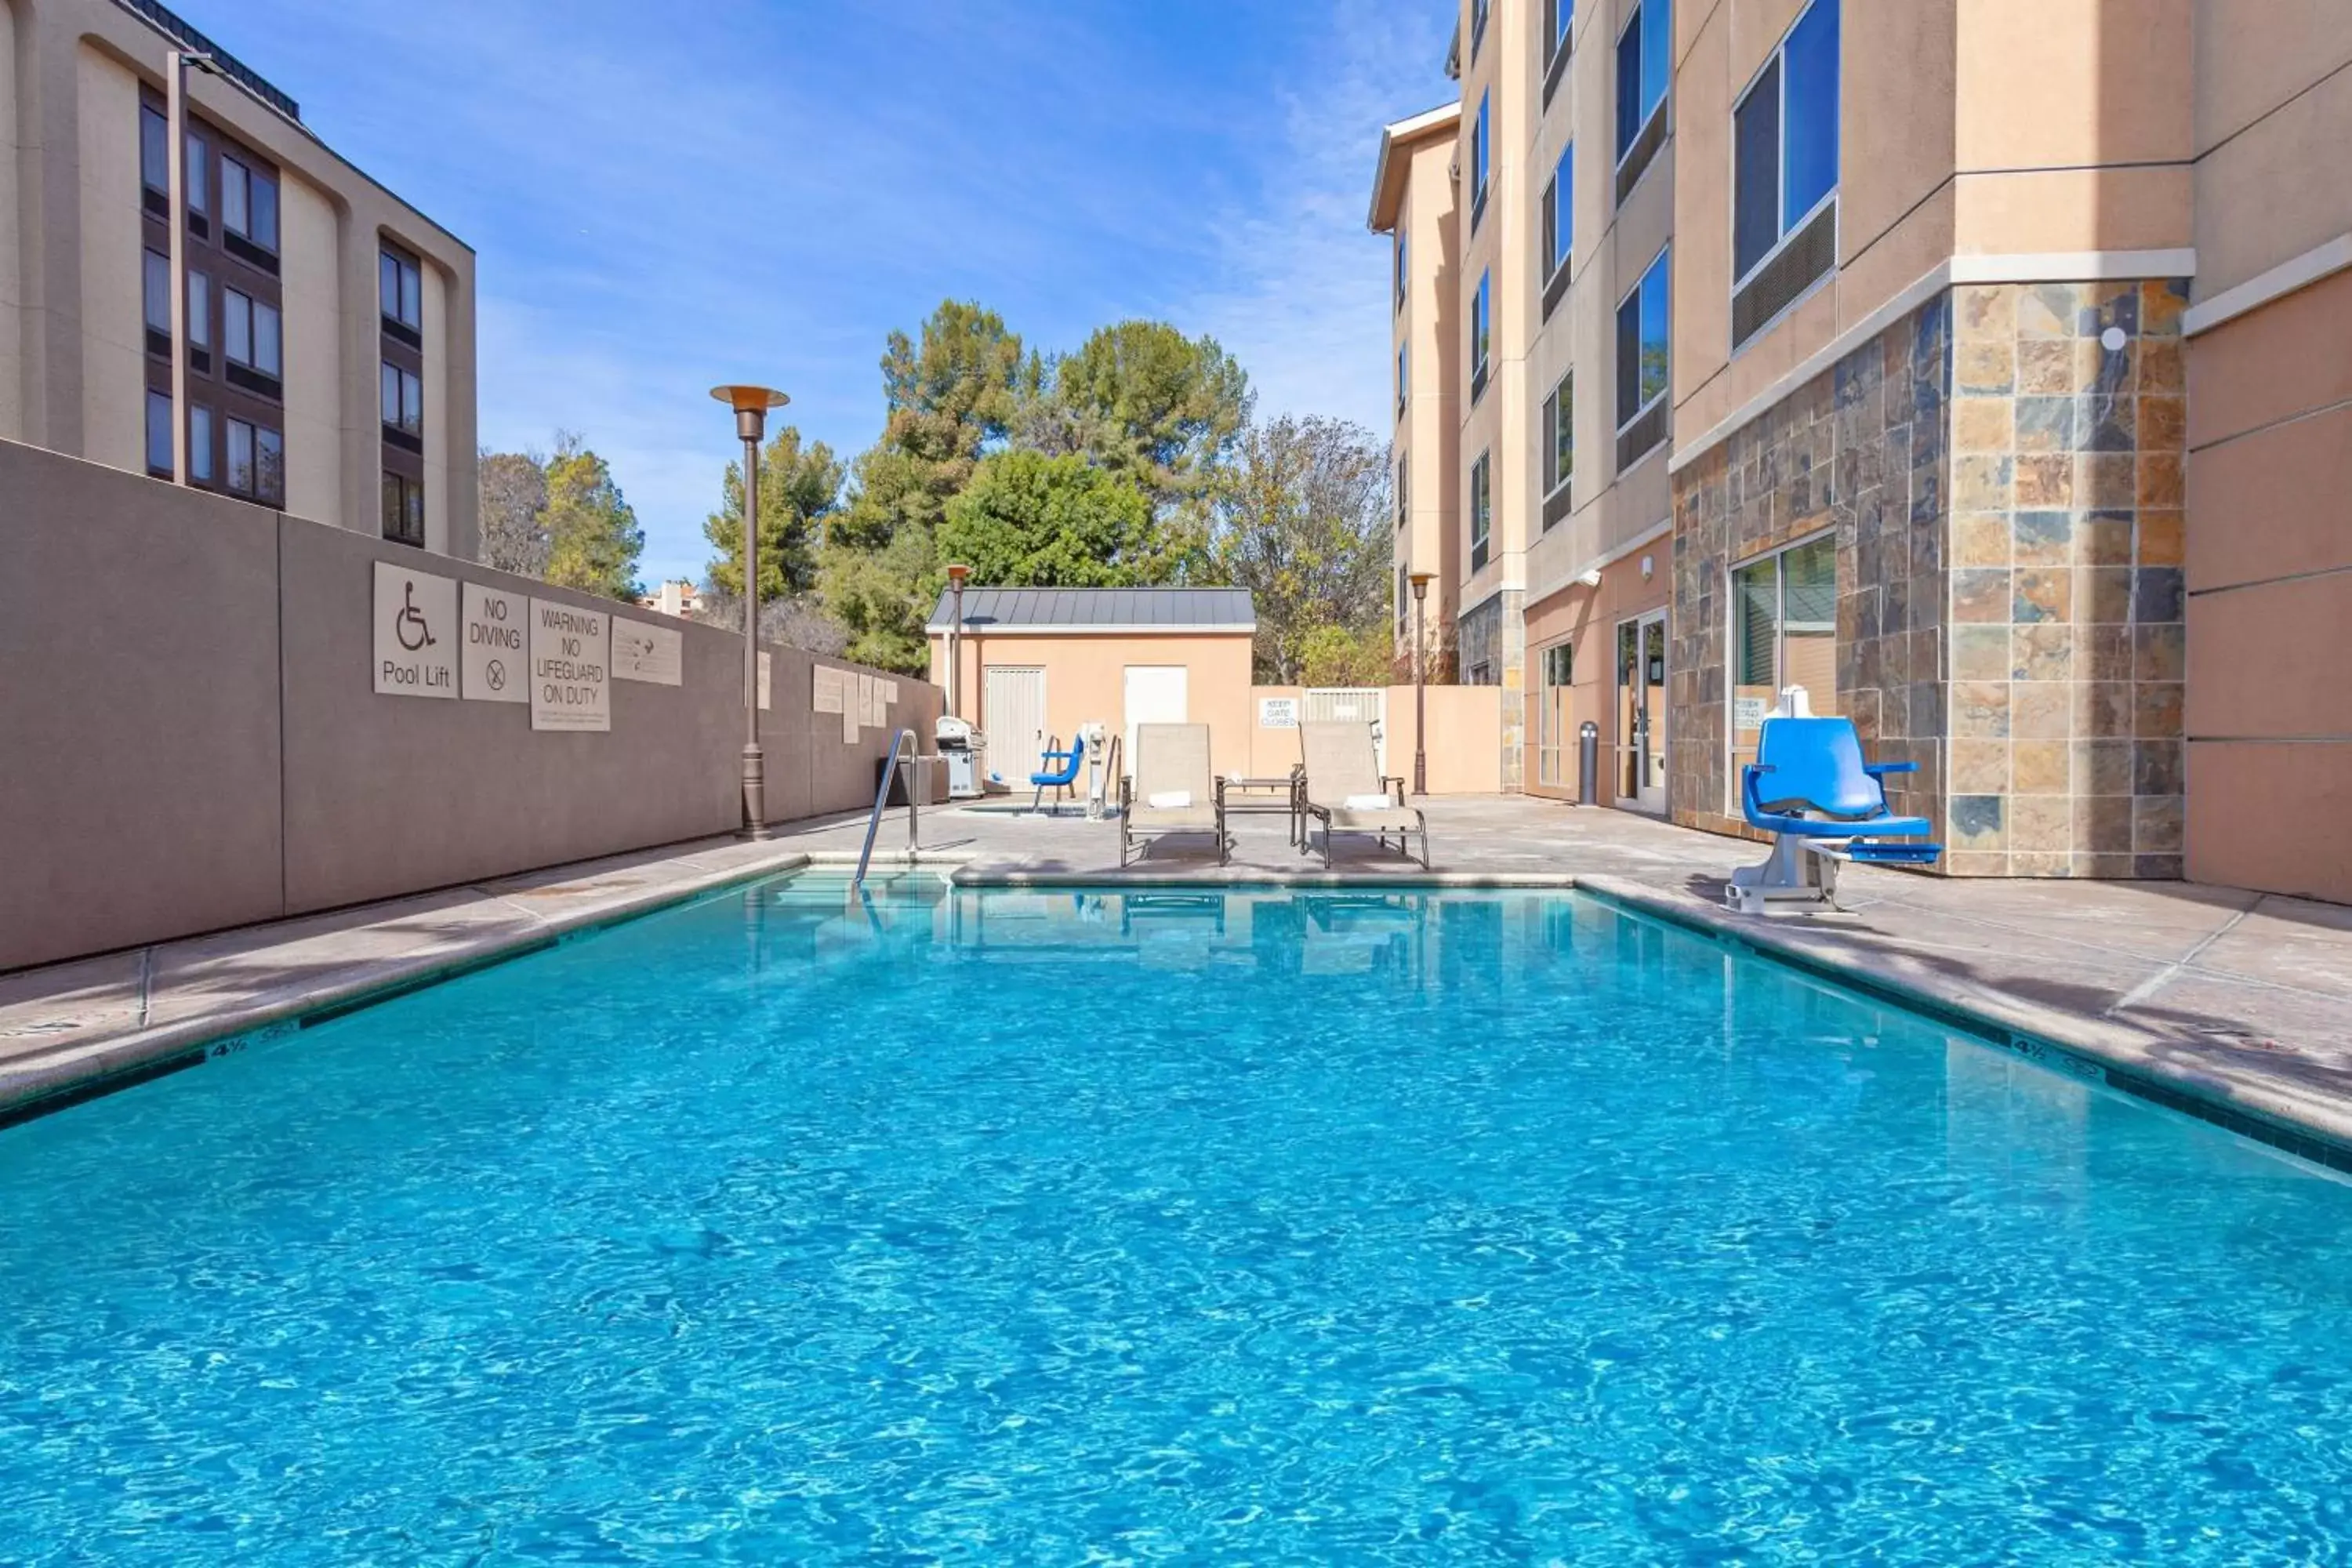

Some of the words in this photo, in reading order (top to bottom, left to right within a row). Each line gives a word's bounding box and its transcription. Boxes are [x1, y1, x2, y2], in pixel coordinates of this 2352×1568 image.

[484, 597, 507, 621] NO
[541, 608, 599, 637] WARNING
[470, 622, 521, 650] DIVING
[561, 637, 581, 657] NO
[383, 660, 419, 685] Pool
[426, 665, 450, 688] Lift
[536, 658, 604, 683] LIFEGUARD
[543, 684, 564, 704] ON
[566, 686, 598, 705] DUTY
